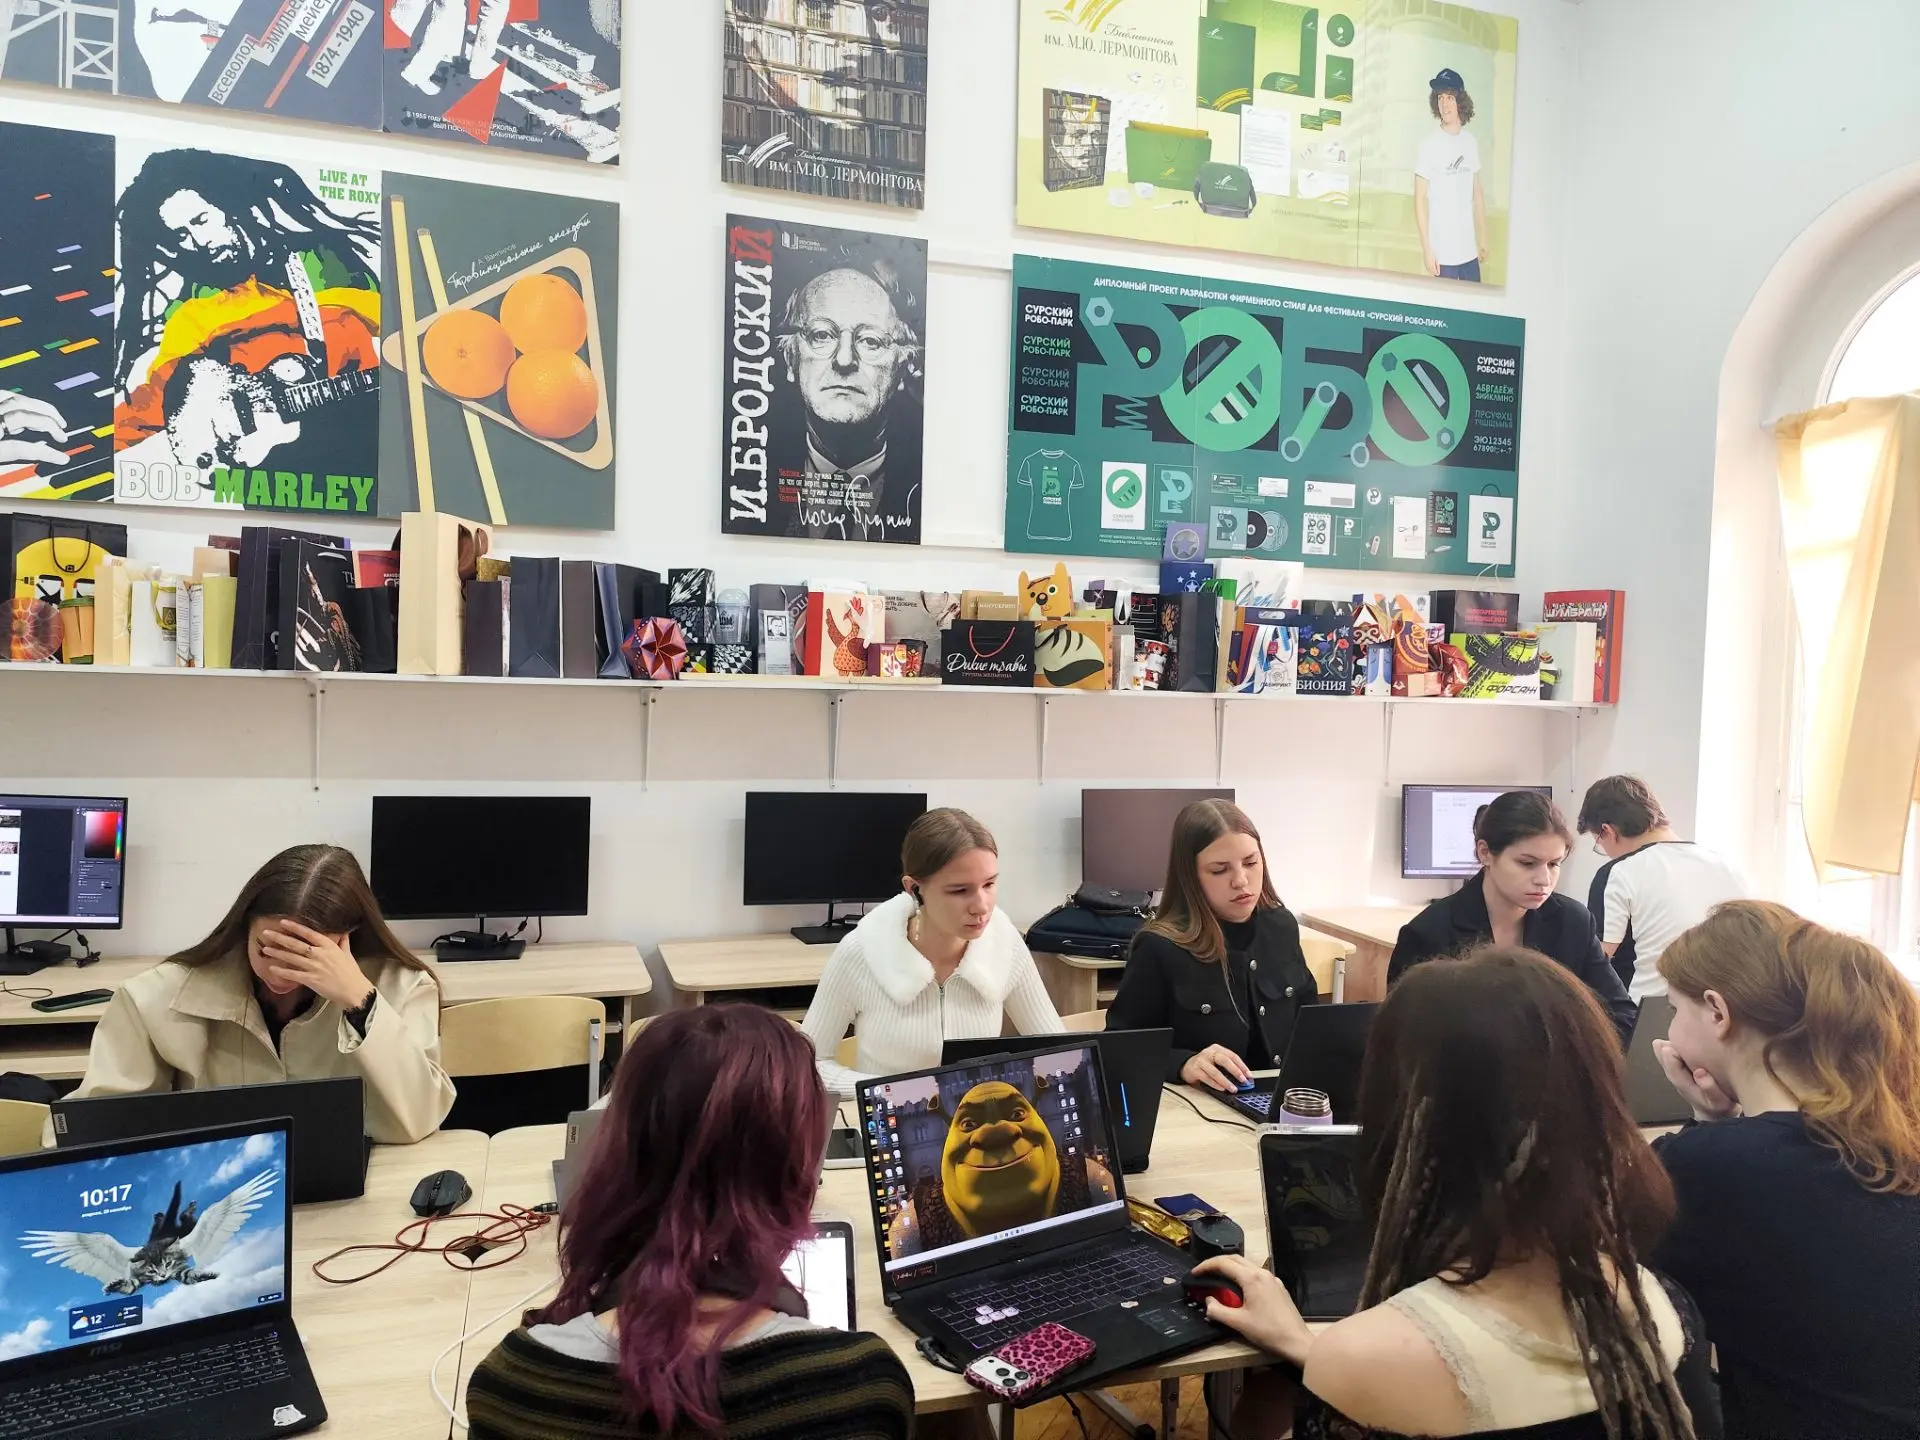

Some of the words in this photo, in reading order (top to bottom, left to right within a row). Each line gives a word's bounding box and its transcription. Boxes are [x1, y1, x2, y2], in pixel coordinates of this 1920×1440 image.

[311, 46, 341, 80] 1874
[336, 9, 365, 43] 1940
[1099, 40, 1178, 65] ЛЕРМОНТОВА
[320, 168, 347, 184] LIVE
[351, 173, 368, 187] AT
[796, 161, 829, 179] М.Ю.
[832, 166, 923, 192] ЛЕРМОНТОВА
[320, 186, 345, 200] THE
[349, 189, 380, 204] ROXY
[1093, 277, 1147, 291] ДИПЛОМНЫЙ
[1149, 283, 1179, 295] ПРОЕКТ
[1180, 287, 1228, 300] РАЗРАБОТКИ
[1230, 293, 1281, 308] ФИРМЕННОГО
[1283, 300, 1306, 311] СТИЛЯ
[1308, 303, 1322, 314] ДЛЯ
[1324, 305, 1366, 319] ФЕСТИВАЛЯ
[1025, 304, 1073, 319] СУРСКИЙ
[1024, 314, 1074, 328] РОБО-ПАРК
[1023, 335, 1071, 349] СУРСКИЙ
[1022, 345, 1071, 357] РОБО-ПАРК
[1477, 356, 1515, 369] СУРСКИЙ
[1022, 366, 1070, 379] СУРСКИЙ
[1476, 365, 1515, 376] РОБО-ПАРК
[1021, 376, 1070, 388] РОБО-ПАРК
[1020, 394, 1068, 408] СУРСКИЙ
[1020, 404, 1069, 416] РОБО-ПАРК
[119, 460, 201, 502] BOB
[213, 467, 375, 512] MARLEY
[947, 652, 988, 673] Дикие
[989, 653, 1029, 674] травы
[1297, 680, 1346, 691] БИОНИЯ
[80, 1184, 132, 1207] 10:17
